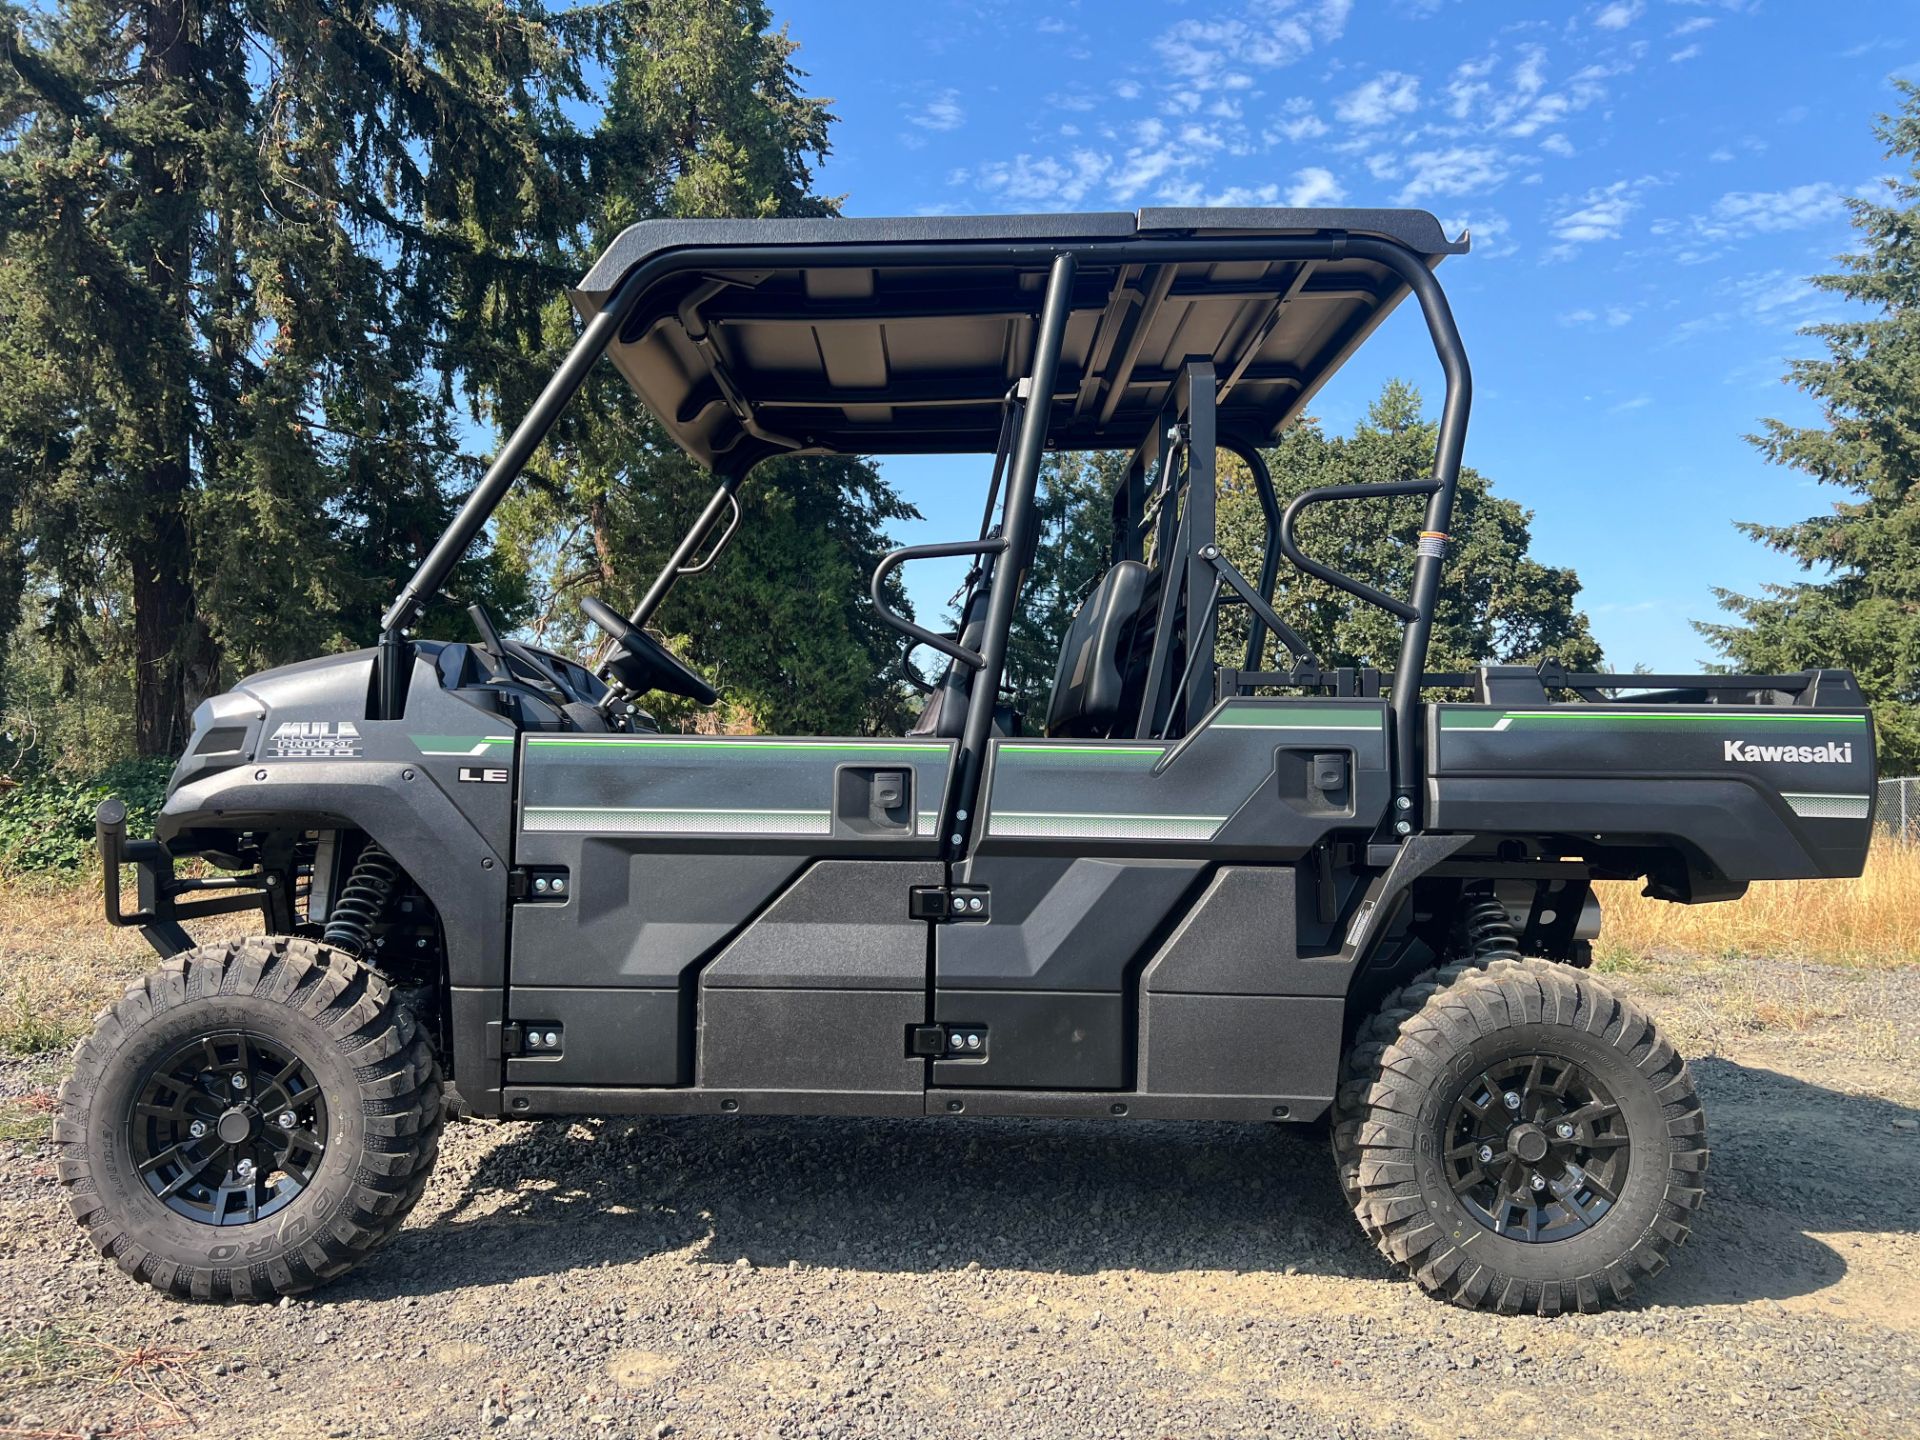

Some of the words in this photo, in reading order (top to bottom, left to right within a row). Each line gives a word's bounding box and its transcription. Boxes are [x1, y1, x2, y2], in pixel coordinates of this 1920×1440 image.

[269, 721, 362, 740] MULE
[277, 748, 354, 757] 1000
[1724, 740, 1852, 763] Kawasaki
[459, 768, 507, 782] LE
[1418, 1051, 1475, 1159] DURO
[207, 1187, 334, 1262] DURO
